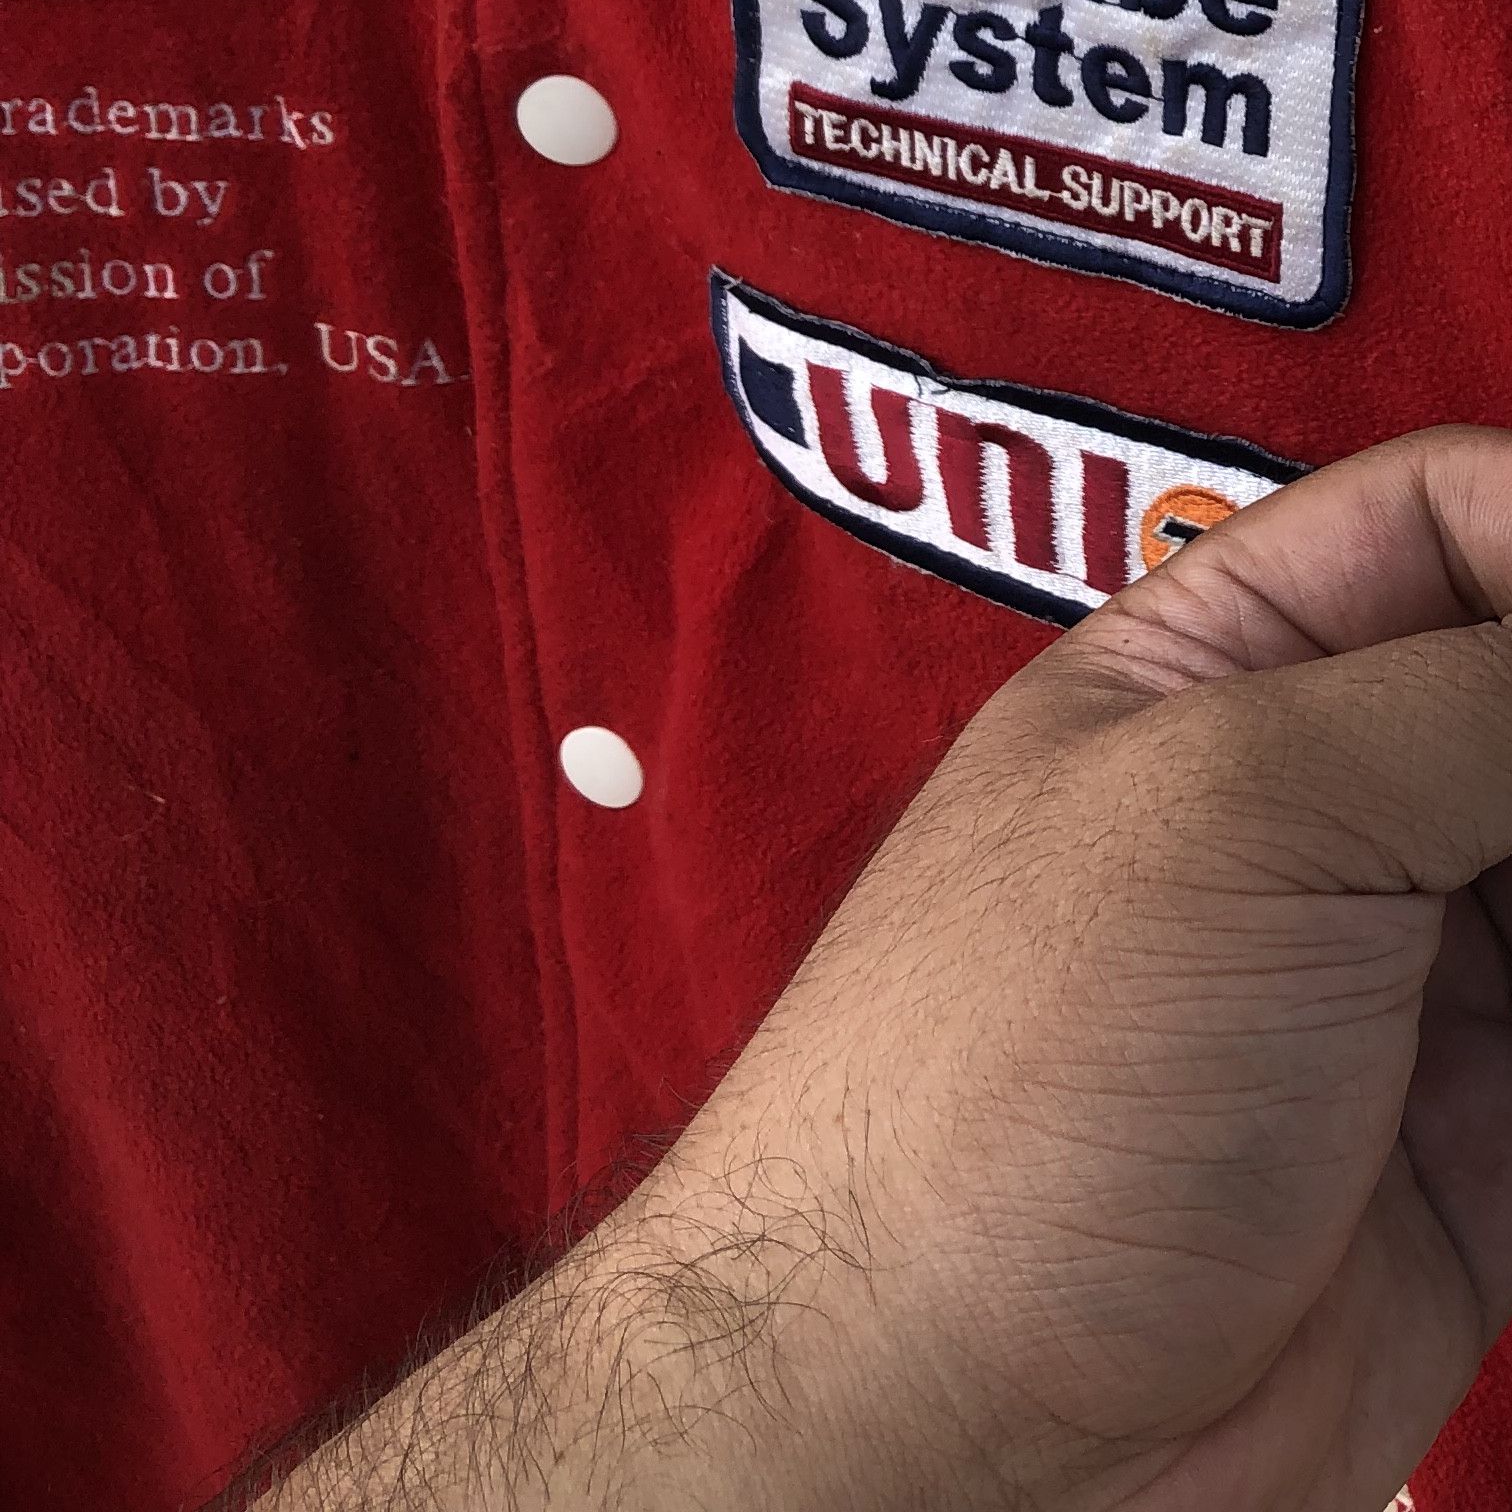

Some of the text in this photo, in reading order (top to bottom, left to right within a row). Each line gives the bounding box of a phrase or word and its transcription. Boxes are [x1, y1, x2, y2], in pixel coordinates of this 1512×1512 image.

[147, 167, 229, 226] by
[793, 100, 1276, 259] TECHNICAL SUPPORT
[203, 249, 276, 300] of
